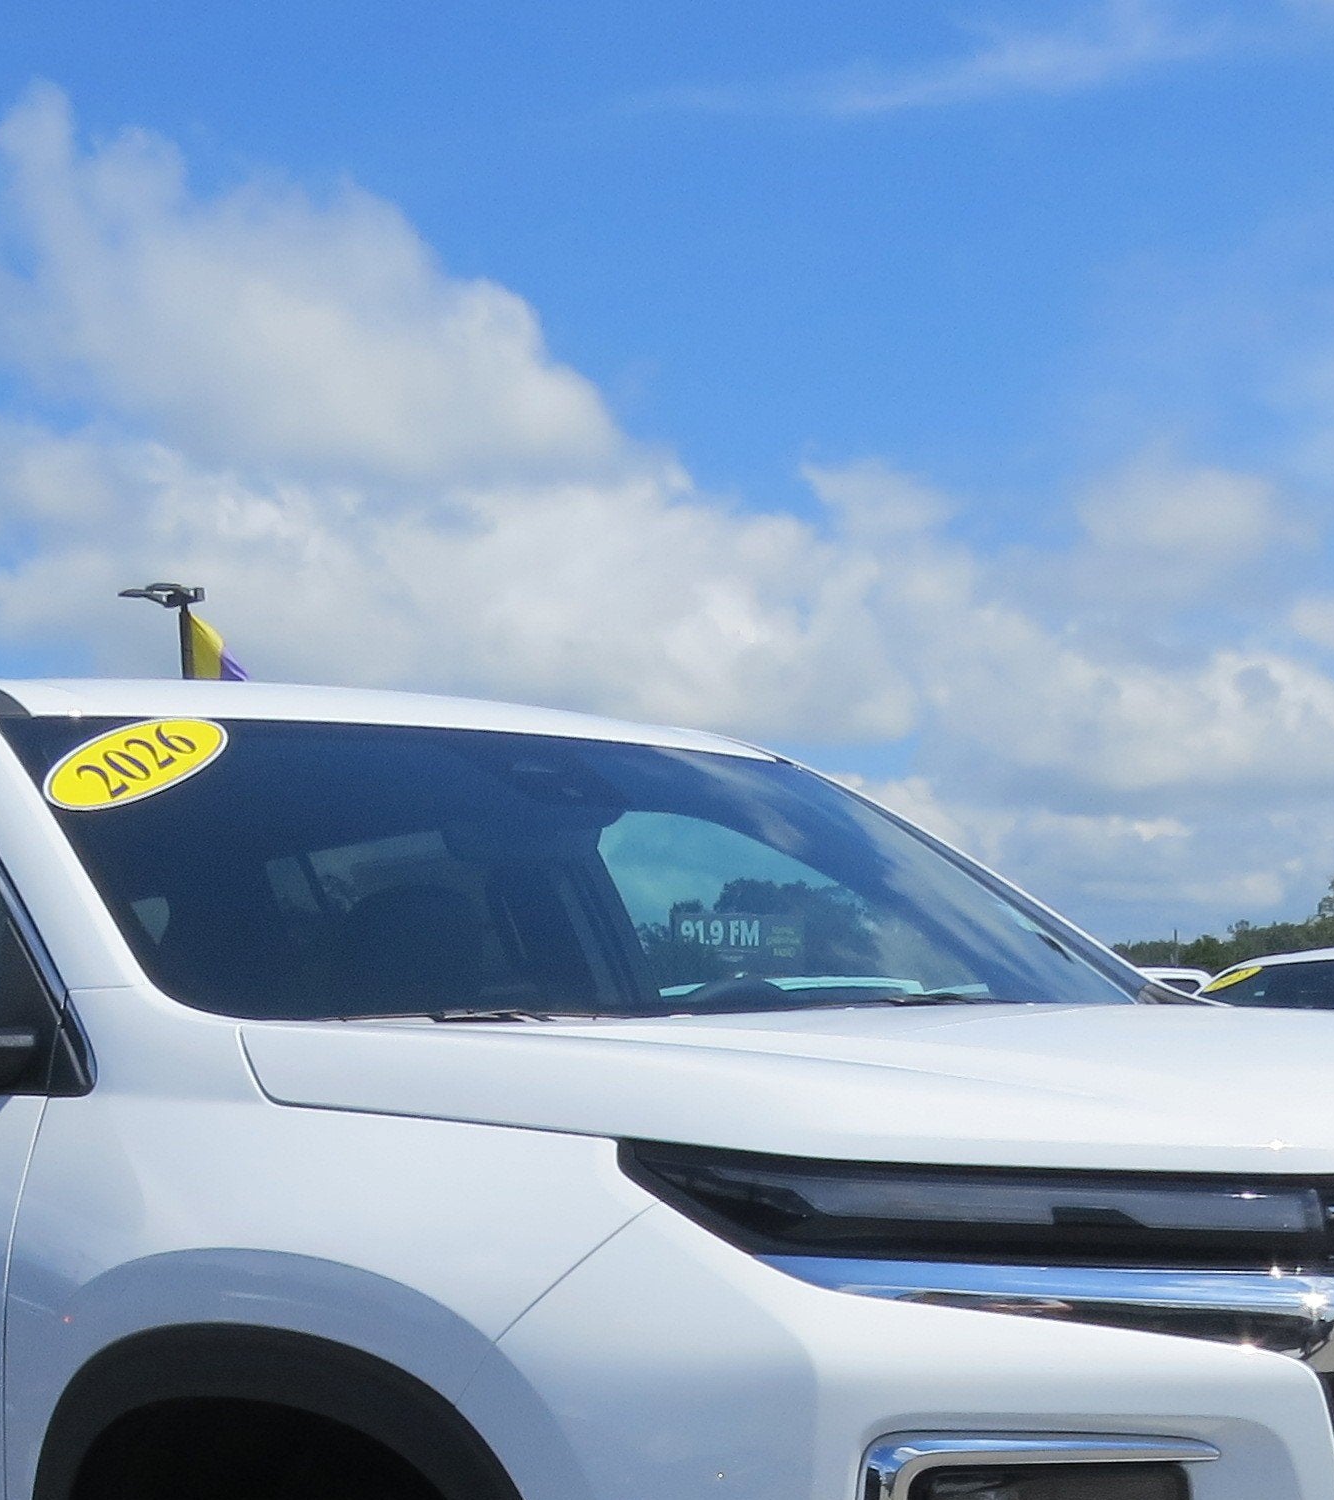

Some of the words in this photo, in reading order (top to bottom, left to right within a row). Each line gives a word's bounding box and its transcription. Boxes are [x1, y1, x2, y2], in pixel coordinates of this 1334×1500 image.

[76, 724, 197, 798] 2026
[681, 919, 724, 946] 91.9
[729, 919, 760, 947] FM
